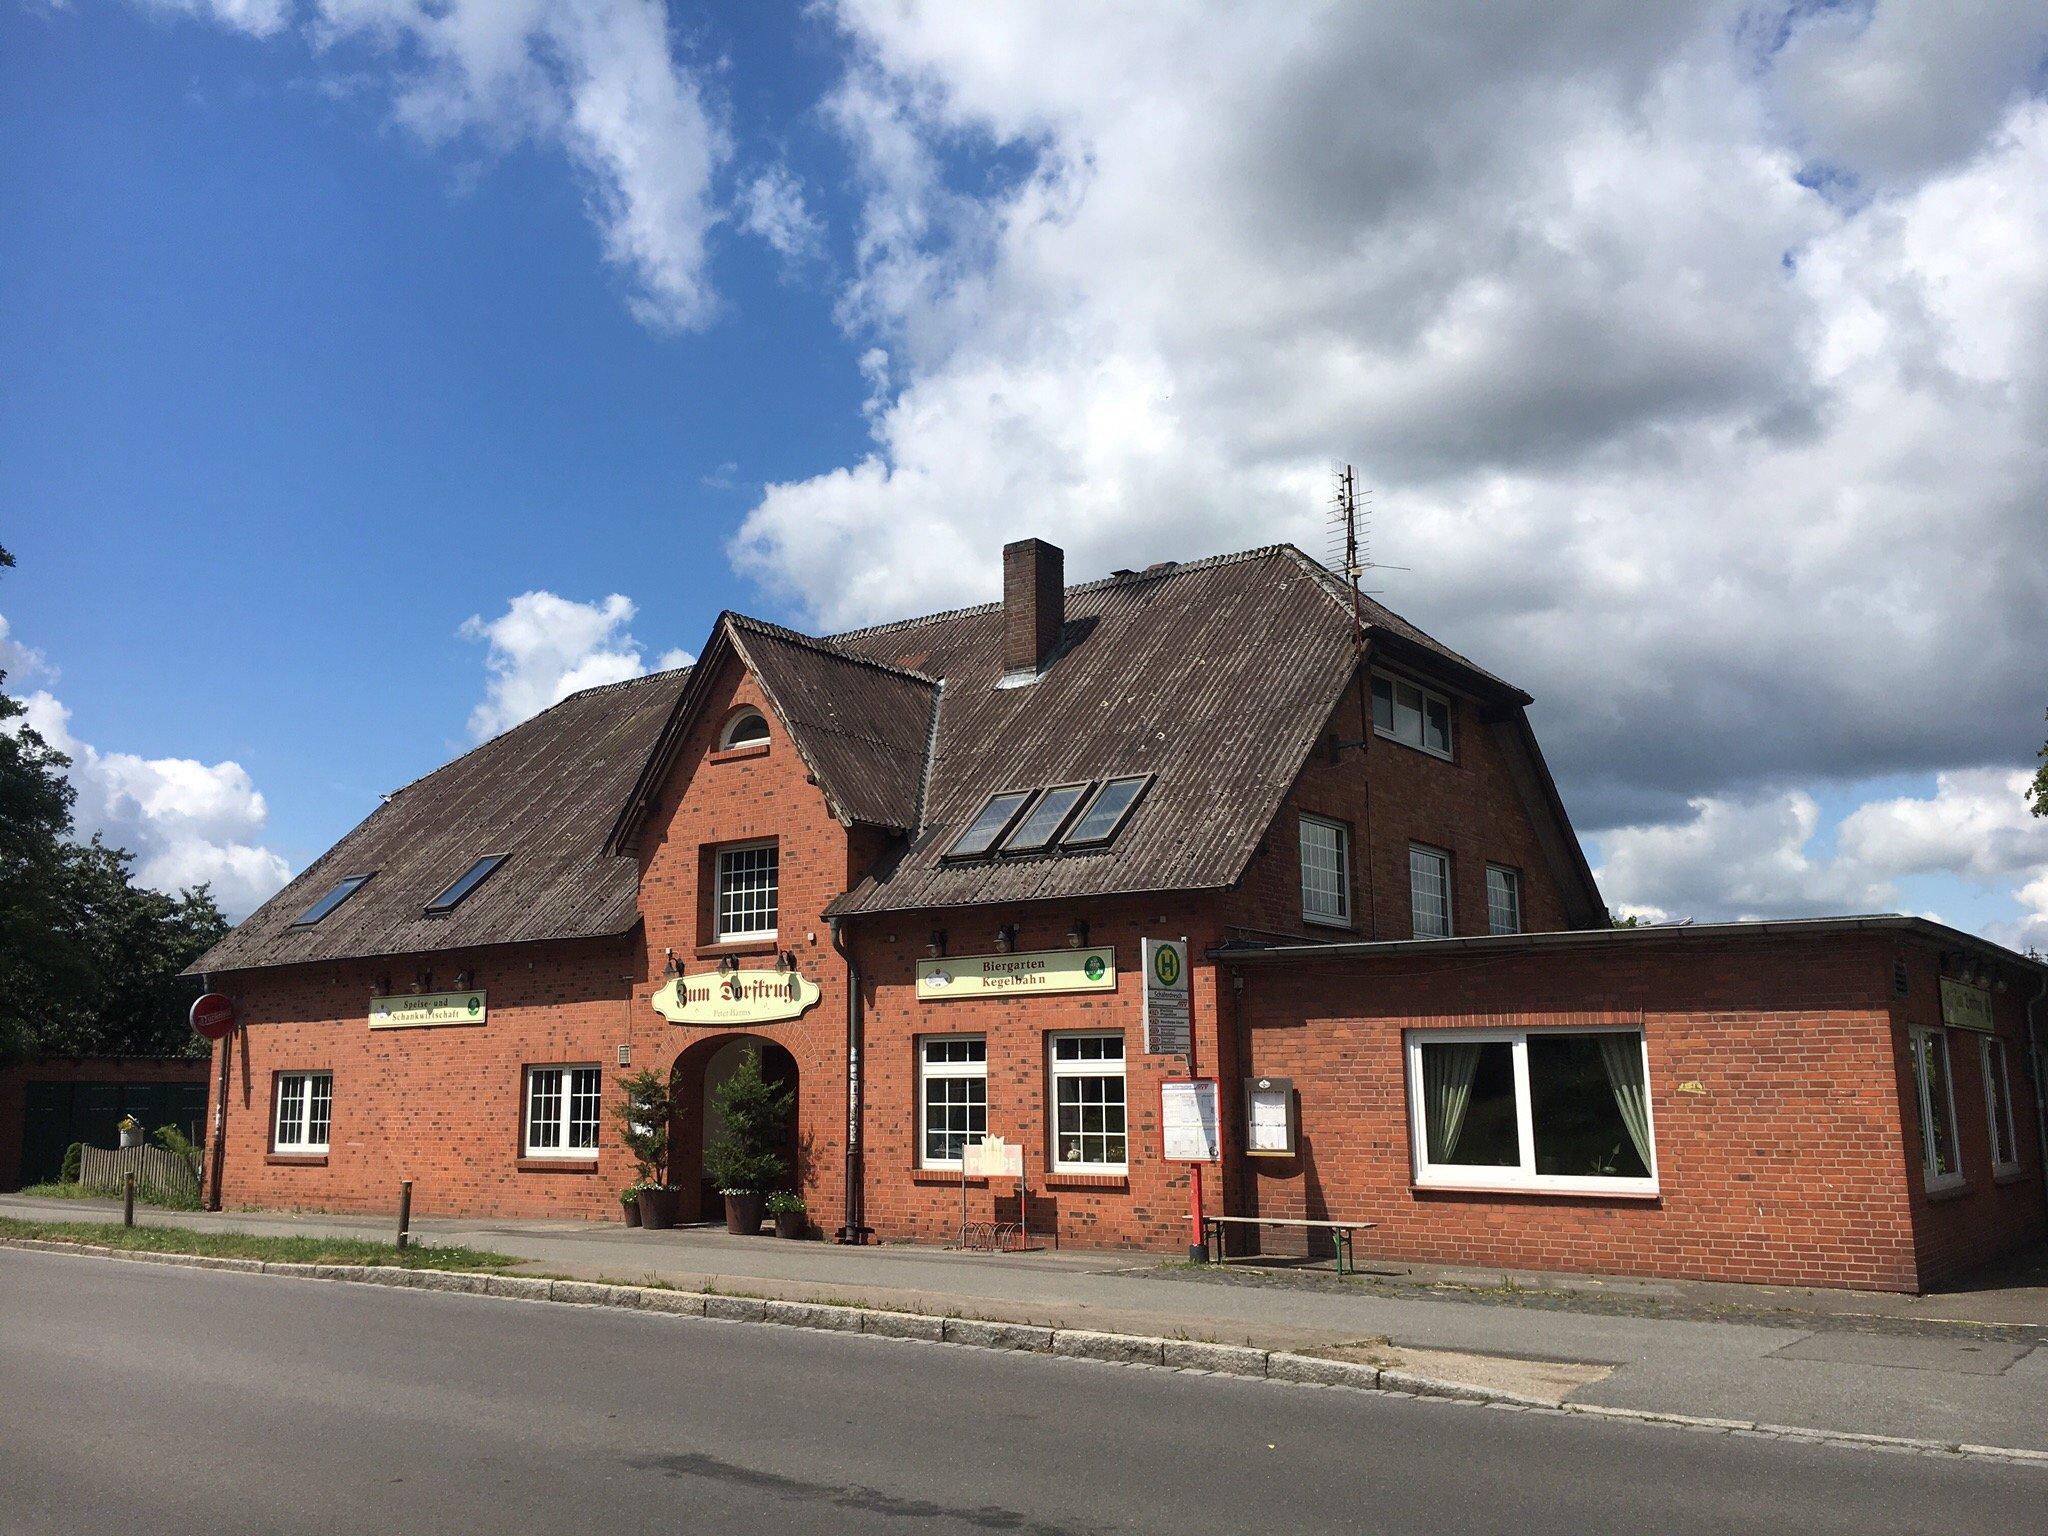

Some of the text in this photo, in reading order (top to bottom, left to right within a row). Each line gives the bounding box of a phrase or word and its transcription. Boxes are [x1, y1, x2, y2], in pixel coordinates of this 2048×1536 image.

[983, 960, 1045, 973] Biergarten
[982, 975, 1046, 988] Kegelbahn
[676, 980, 795, 1010] Zum Dorfkrug
[403, 998, 448, 1010] Speise- und
[392, 1011, 459, 1021] Schankwirtschaft
[713, 1010, 730, 1018] Peter
